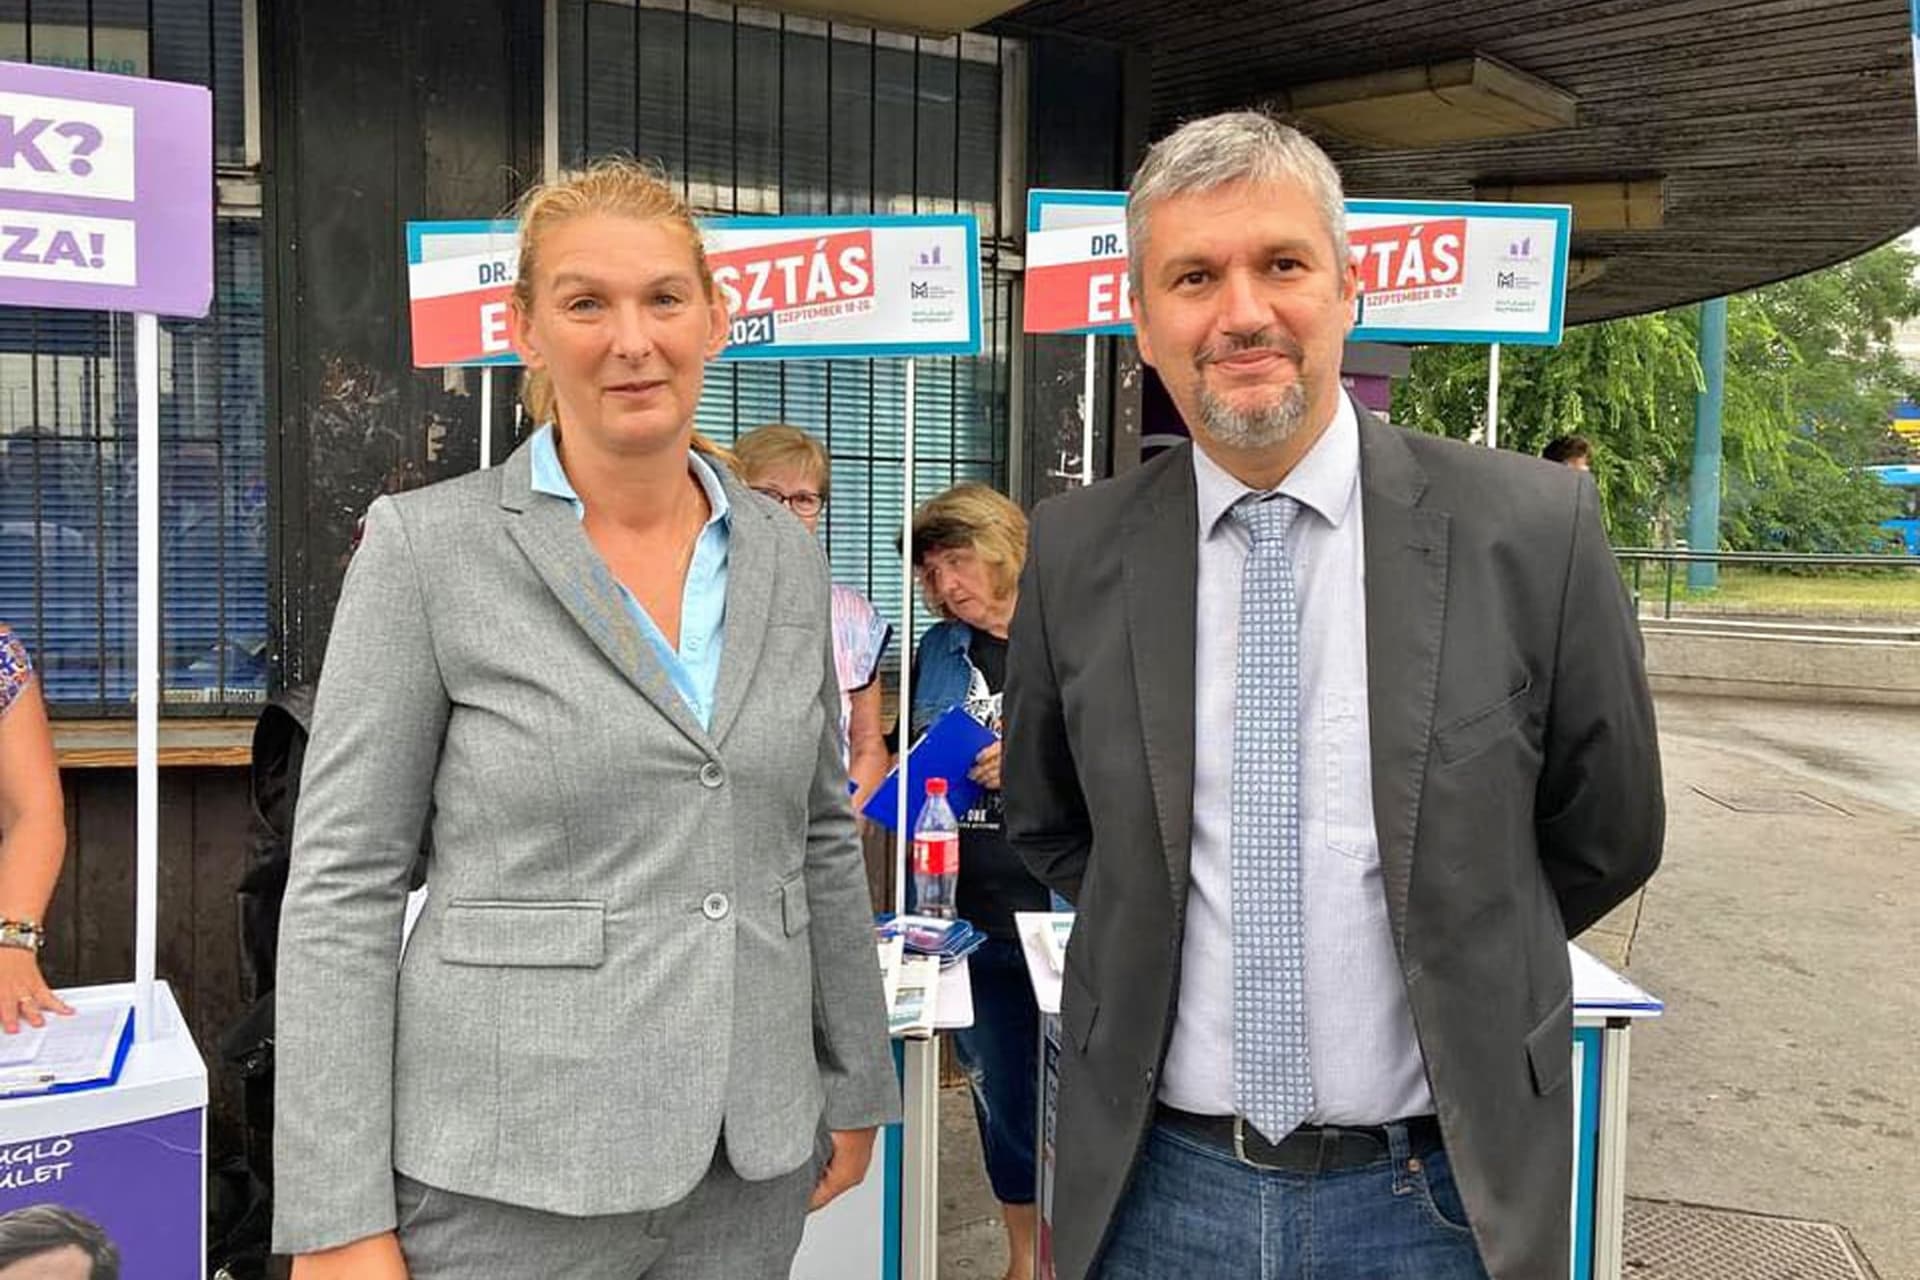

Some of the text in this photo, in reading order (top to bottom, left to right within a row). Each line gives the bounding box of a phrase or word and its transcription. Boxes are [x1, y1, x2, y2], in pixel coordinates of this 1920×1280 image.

[0, 114, 104, 177] K?
[2, 226, 105, 269] ZA!
[1091, 233, 1123, 256] DR.
[478, 262, 513, 285] DR.
